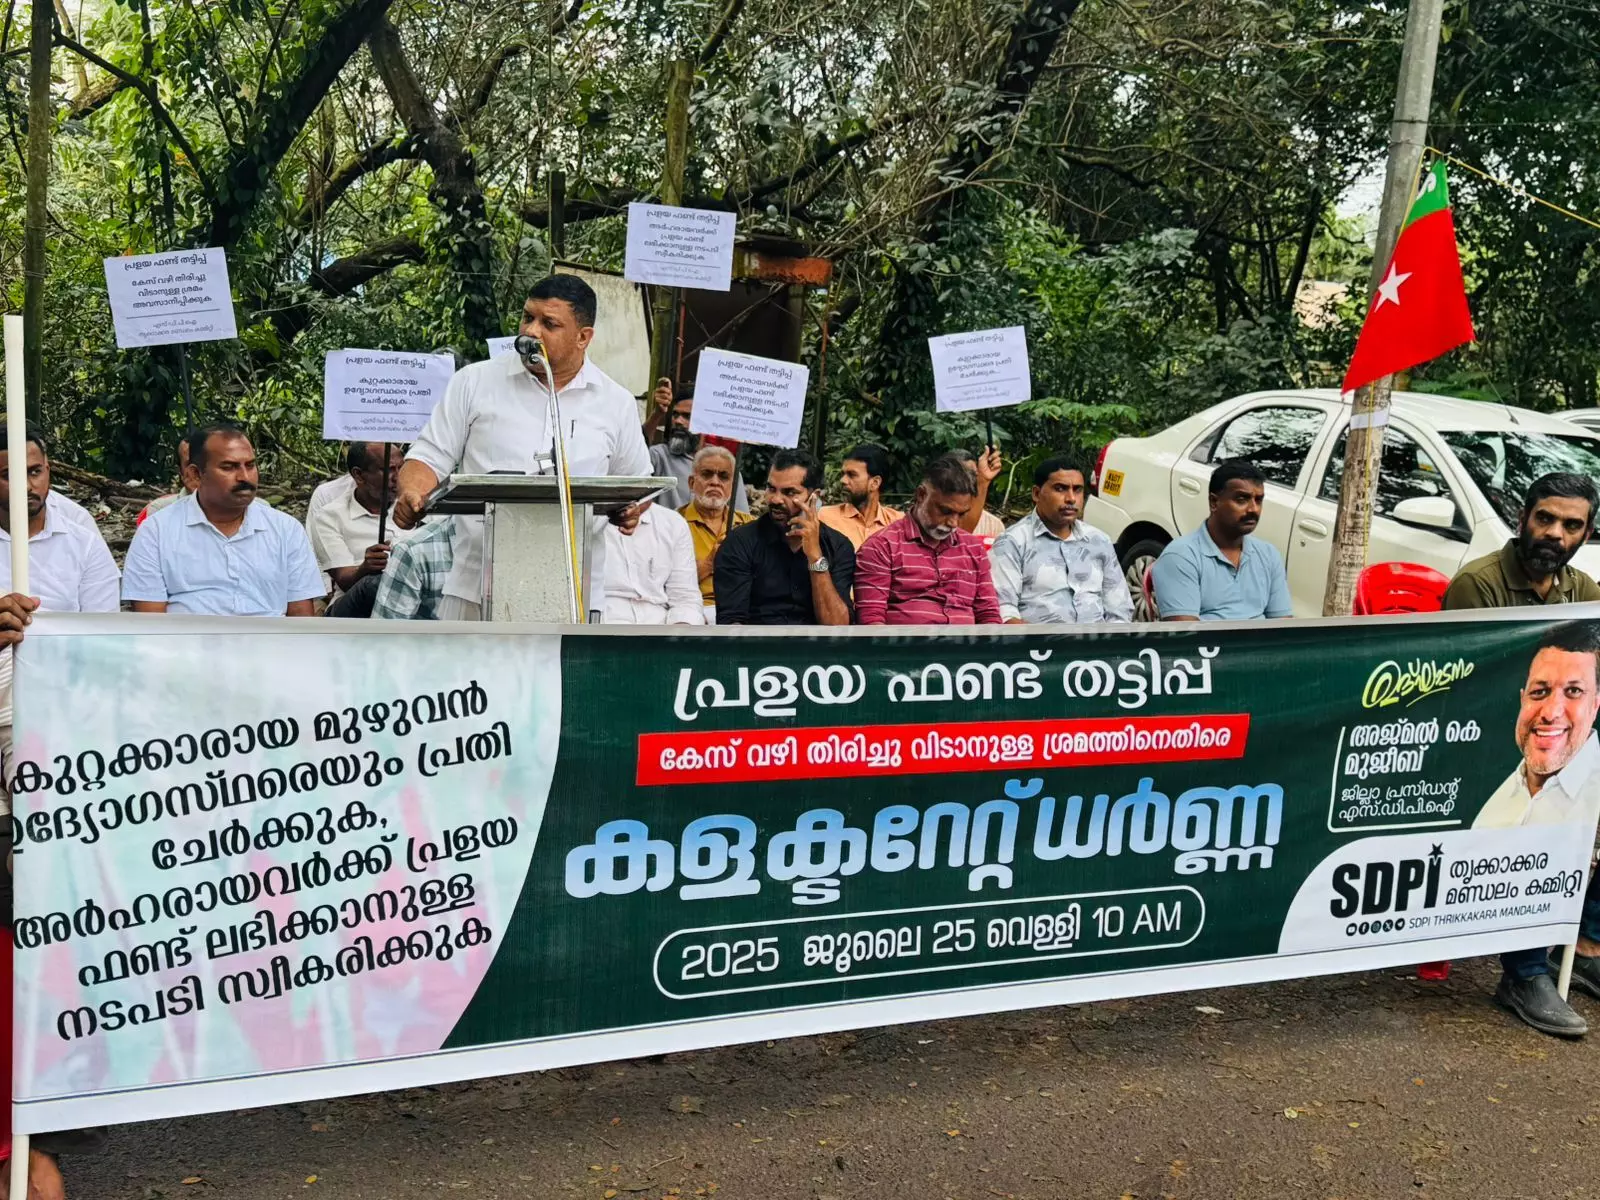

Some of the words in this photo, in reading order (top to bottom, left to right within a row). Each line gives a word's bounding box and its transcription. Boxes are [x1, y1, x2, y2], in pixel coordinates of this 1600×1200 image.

[124, 261, 152, 271] പ്രളയ
[154, 256, 178, 267] ഫണ്ട്
[180, 253, 207, 264] തട്ടിപ്പ്
[132, 277, 156, 286] കേസ്
[158, 275, 174, 284] വഴി
[175, 273, 206, 282] തിരിച്ചു
[133, 296, 212, 309] അവസാനിപ്പിക്കുക
[138, 288, 180, 298] വിടാനുള്ള
[346, 357, 373, 365] പ്രളയ
[401, 359, 426, 369] തട്ടിപ്പ്
[718, 360, 743, 369] പ്രളയ
[360, 378, 418, 386] കുറ്റക്കാരായ
[409, 388, 431, 396] പ്രതി
[673, 664, 867, 721] പ്രളയ
[888, 649, 1052, 702] ഫണ്ട്
[1063, 646, 1220, 709] തട്ടിപ്പ്
[13, 714, 299, 795] കുറ്റക്കാരായ
[313, 680, 489, 744] മുഴുവൻ
[418, 721, 512, 778] പ്രതി
[659, 737, 742, 771] കേസ്
[747, 735, 797, 767] വഴി
[807, 733, 902, 767] തിരിച്ചു
[911, 730, 1034, 763] വിടാനുള്ള
[1043, 721, 1232, 761] ശ്രമത്തിനെതിരെ
[1350, 717, 1440, 747] അജ്മൽ
[1445, 720, 1481, 743] കെ
[1345, 745, 1429, 780] മുജീബ്
[1341, 784, 1380, 805] ജില്ലാ
[152, 799, 388, 871] ചേർക്കുക,
[565, 777, 1044, 906] കളക്ടറേറ്റ്
[1033, 777, 1284, 875] ധർണ്ണ
[13, 832, 399, 950] അർഹരായവർക്ക്
[406, 815, 519, 873] പ്രളയ
[1330, 847, 1443, 919] SDPI
[1449, 852, 1549, 884] തൃക്കാക്കര
[1445, 881, 1519, 906] മണ്ഡലം
[1525, 869, 1583, 898] കമ്മിറ്റി
[77, 925, 197, 987] ഫണ്ട്
[206, 872, 476, 962] ലഭിക്കാനുള്ള
[1409, 915, 1431, 930] SDPI
[1434, 908, 1498, 927] THRIKKAKARA
[1500, 902, 1552, 919] MANDALAM
[681, 937, 779, 981] 2025
[803, 926, 921, 974] ജൂലൈ
[932, 918, 976, 954] 25
[986, 902, 1081, 951] വെള്ളി
[1091, 906, 1125, 938] 10
[1132, 901, 1182, 934] AM
[56, 977, 206, 1041] നടപടി
[217, 916, 493, 1006] സ്വീകരിക്കുക
